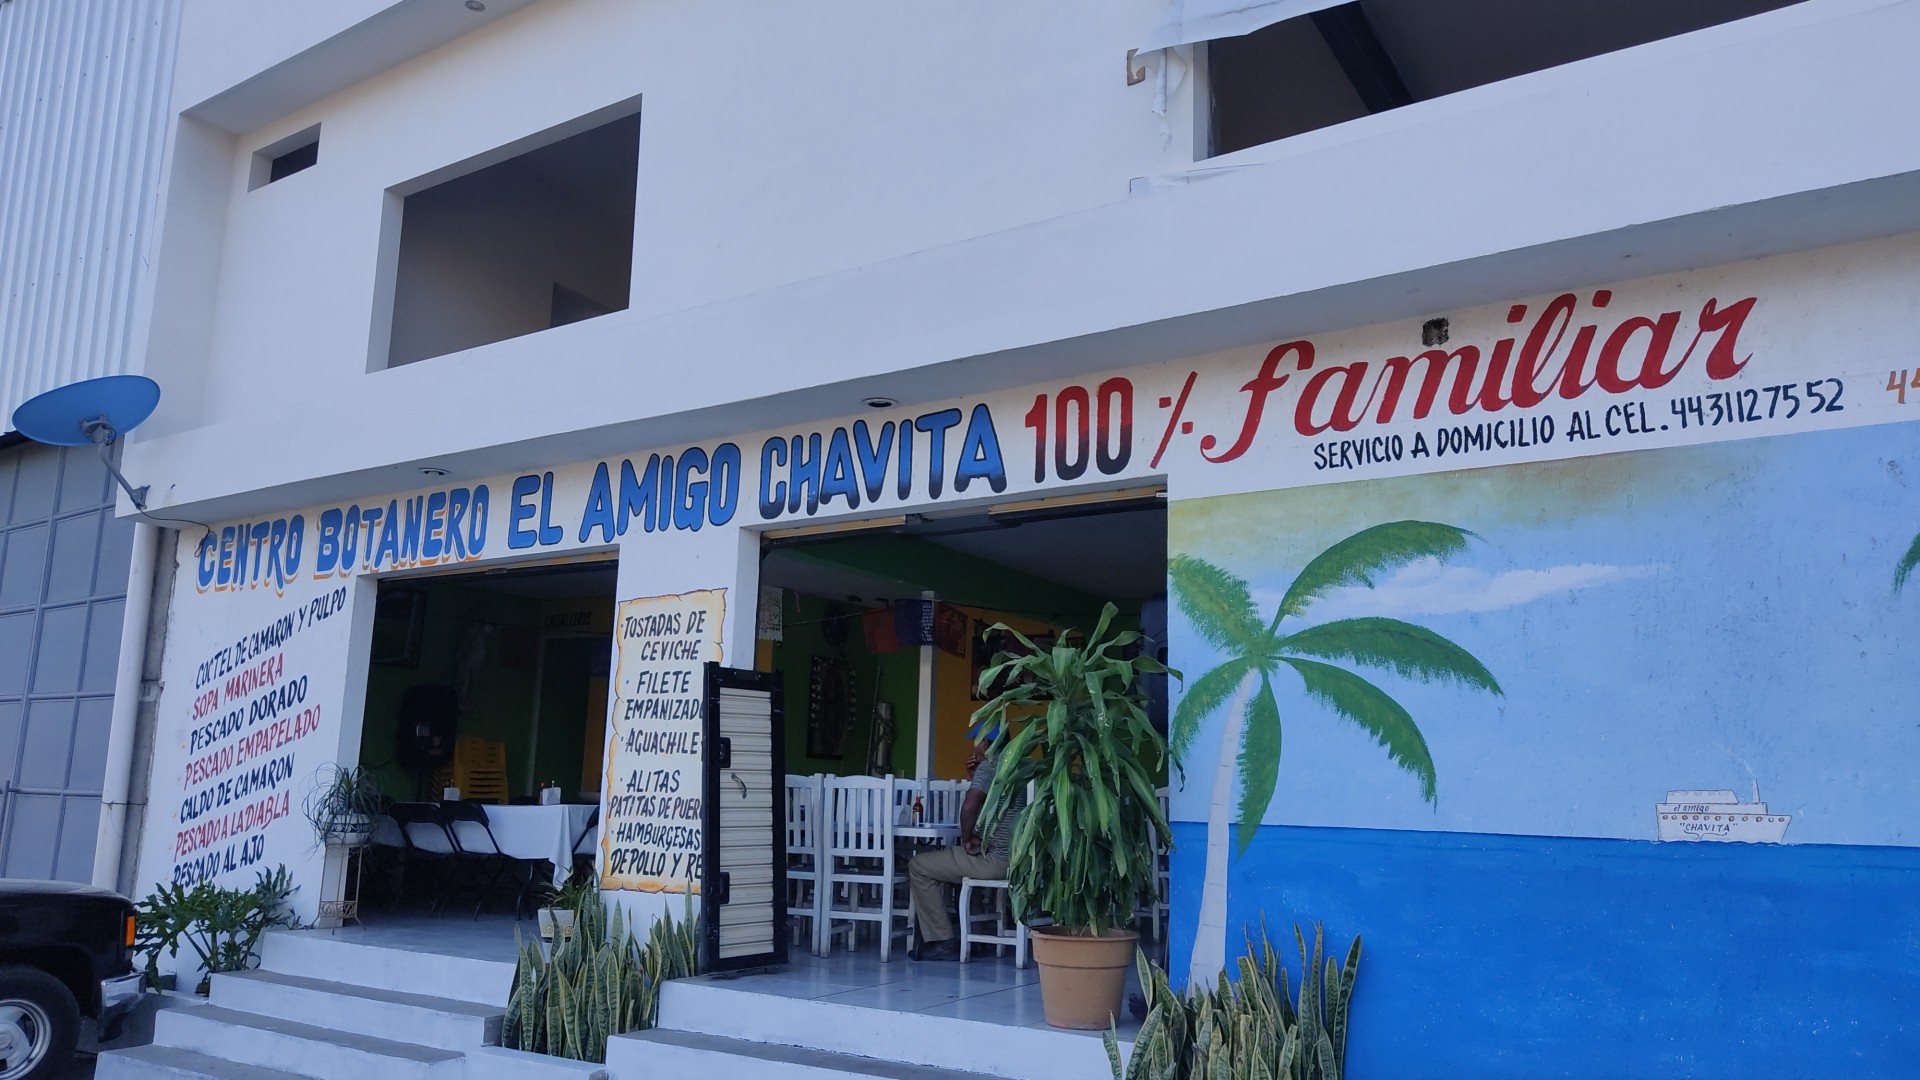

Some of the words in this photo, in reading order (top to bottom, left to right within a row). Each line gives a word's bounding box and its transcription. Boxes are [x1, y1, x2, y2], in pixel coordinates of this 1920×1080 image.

[195, 514, 305, 598] CENTRO
[313, 484, 490, 580] BOTANERO
[507, 471, 564, 551] EL
[578, 442, 742, 544] AMIGO
[758, 402, 1008, 520] CHAVITA
[1200, 289, 1757, 464] familiar
[1313, 434, 1404, 471] SERVICIO
[1410, 431, 1430, 459] A
[1436, 414, 1555, 458] DOMICILIO
[1565, 410, 1601, 442] AL
[195, 647, 232, 690] COCTEL
[235, 636, 247, 668] DE
[248, 611, 295, 660] CAMARON
[297, 604, 308, 633] Y
[308, 585, 347, 628] PULPO
[624, 612, 681, 639] TOSTADAS
[686, 610, 707, 634] DE
[641, 639, 701, 661] CEVICHE
[192, 687, 219, 721] SOPA
[223, 652, 284, 706] MARINERA
[636, 670, 692, 694] FILETE
[190, 707, 244, 756] PESCADO
[249, 675, 308, 726] DORADO
[184, 744, 234, 791] PESCADO
[236, 703, 321, 767] EMPAPELADO
[625, 727, 700, 756] AGUACHILE
[180, 787, 214, 824] CALDO
[216, 778, 233, 808] DE
[234, 752, 295, 800] CAMARON
[626, 769, 681, 793] ALITAS
[609, 795, 656, 819] PATITAS
[657, 797, 673, 819] DE
[672, 796, 702, 820] PUER
[1673, 804, 1681, 812] el
[1682, 804, 1710, 814] amigo
[174, 818, 221, 863] PESCADO
[221, 814, 228, 840] A
[616, 822, 701, 852] HAMBURGESAS
[172, 850, 220, 888] PESCADO
[222, 843, 237, 875] AL
[240, 834, 264, 868] AJO
[670, 852, 683, 878] Y
